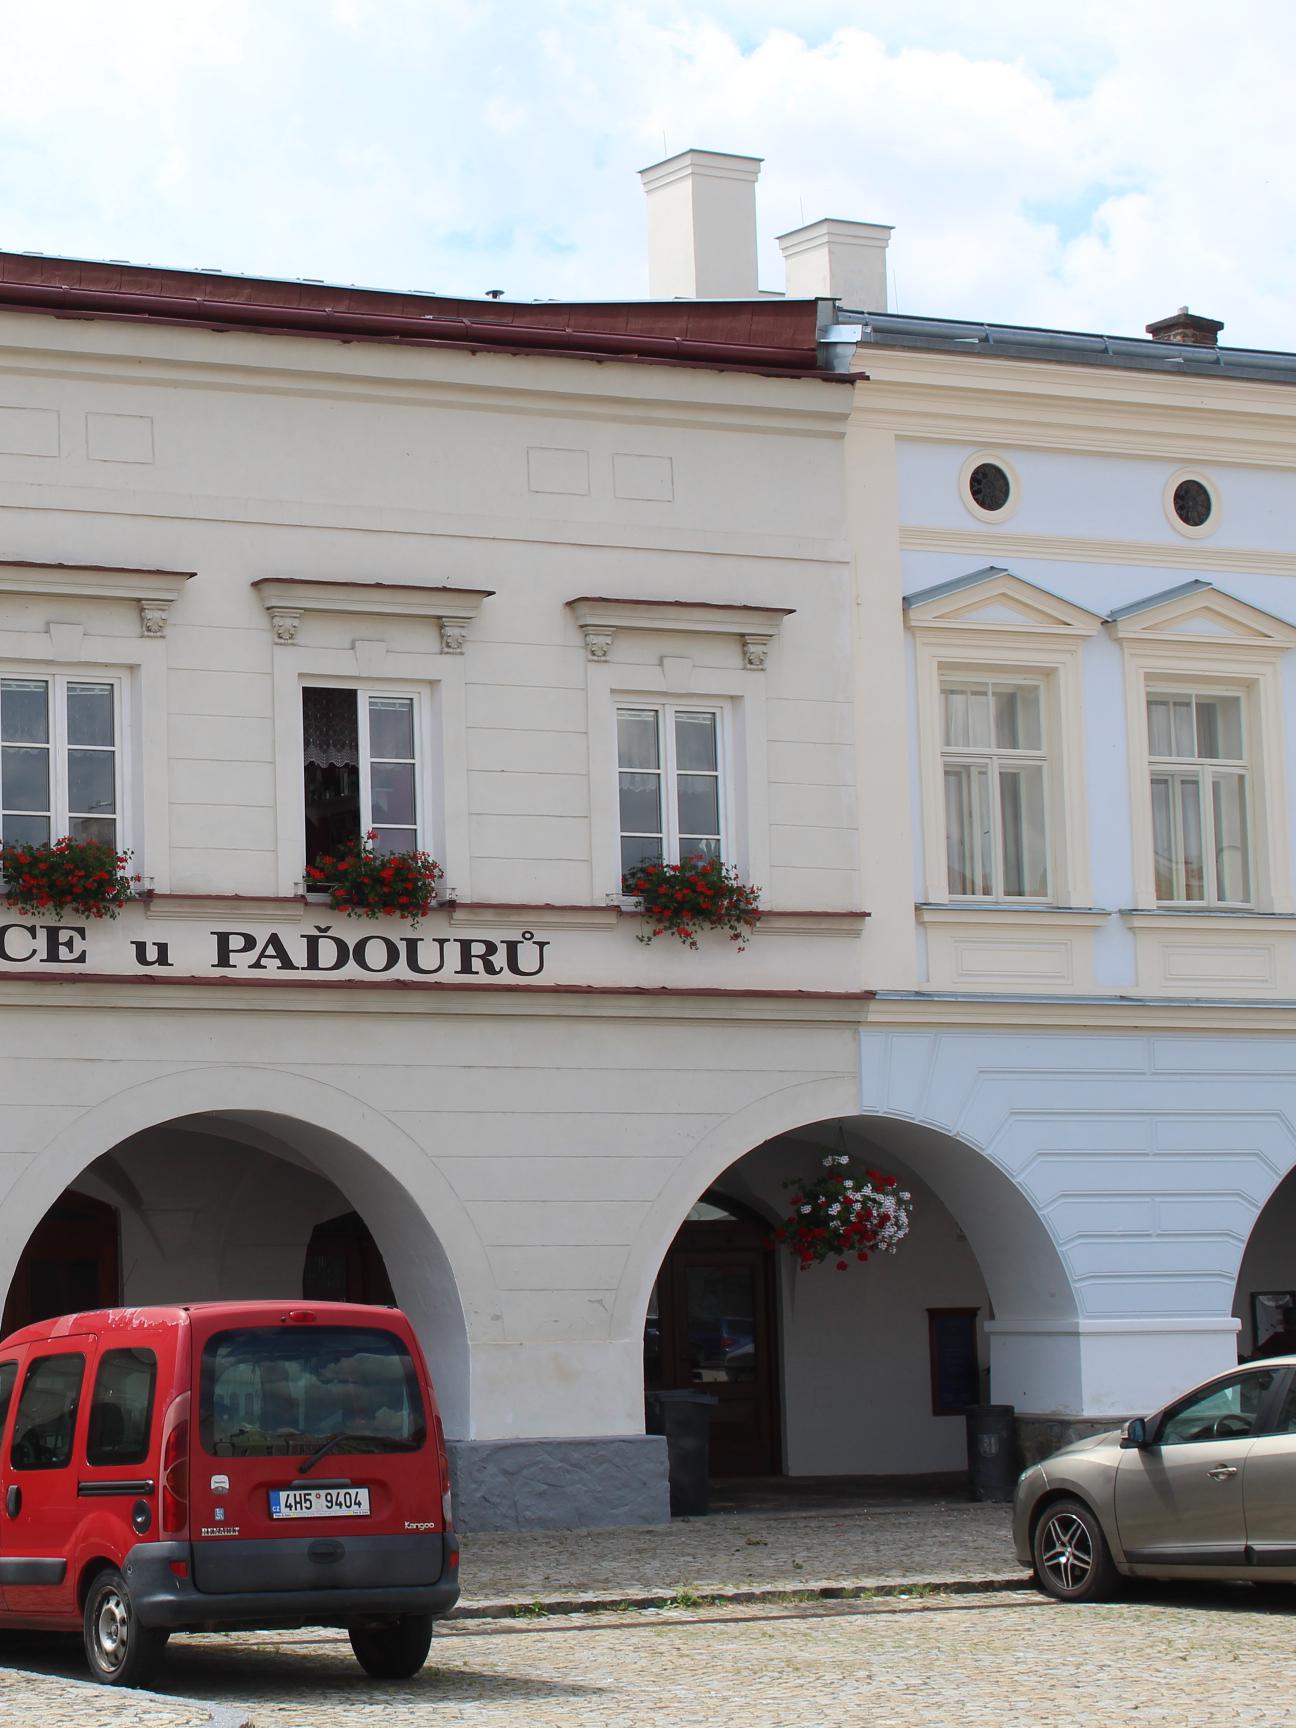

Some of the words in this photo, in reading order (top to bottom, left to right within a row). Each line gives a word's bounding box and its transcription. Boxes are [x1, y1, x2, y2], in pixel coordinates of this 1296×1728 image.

[130, 940, 174, 967] u
[210, 925, 550, 977] PAĎOURŮ
[284, 1492, 313, 1511] 4H5
[324, 1490, 363, 1510] 9404
[201, 1527, 240, 1537] RENAULT
[404, 1521, 435, 1531] Kangoo
